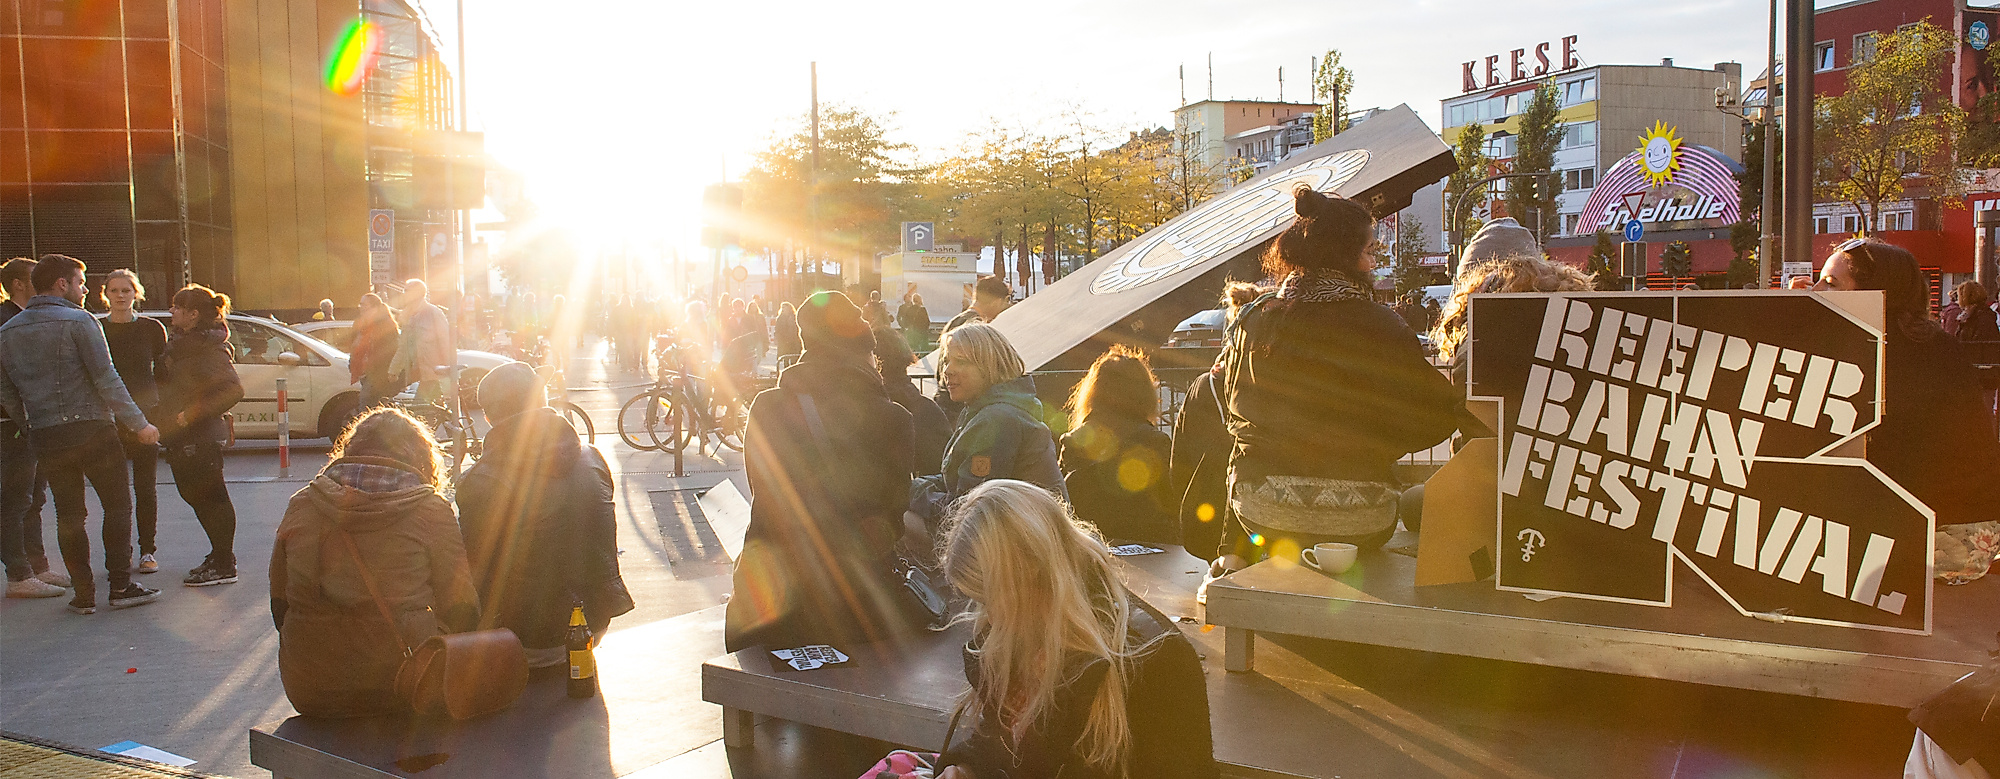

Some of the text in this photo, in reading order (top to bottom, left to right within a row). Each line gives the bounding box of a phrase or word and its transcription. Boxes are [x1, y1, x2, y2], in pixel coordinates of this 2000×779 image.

[1971, 27, 1988, 40] 50
[1462, 34, 1578, 93] KEESE
[1599, 195, 1727, 231] Spelhalle
[372, 240, 391, 249] TAXI
[914, 231, 925, 244] P
[1534, 296, 1865, 437] REEPER
[236, 412, 274, 422] TAXI
[1517, 363, 1765, 489] BAHN
